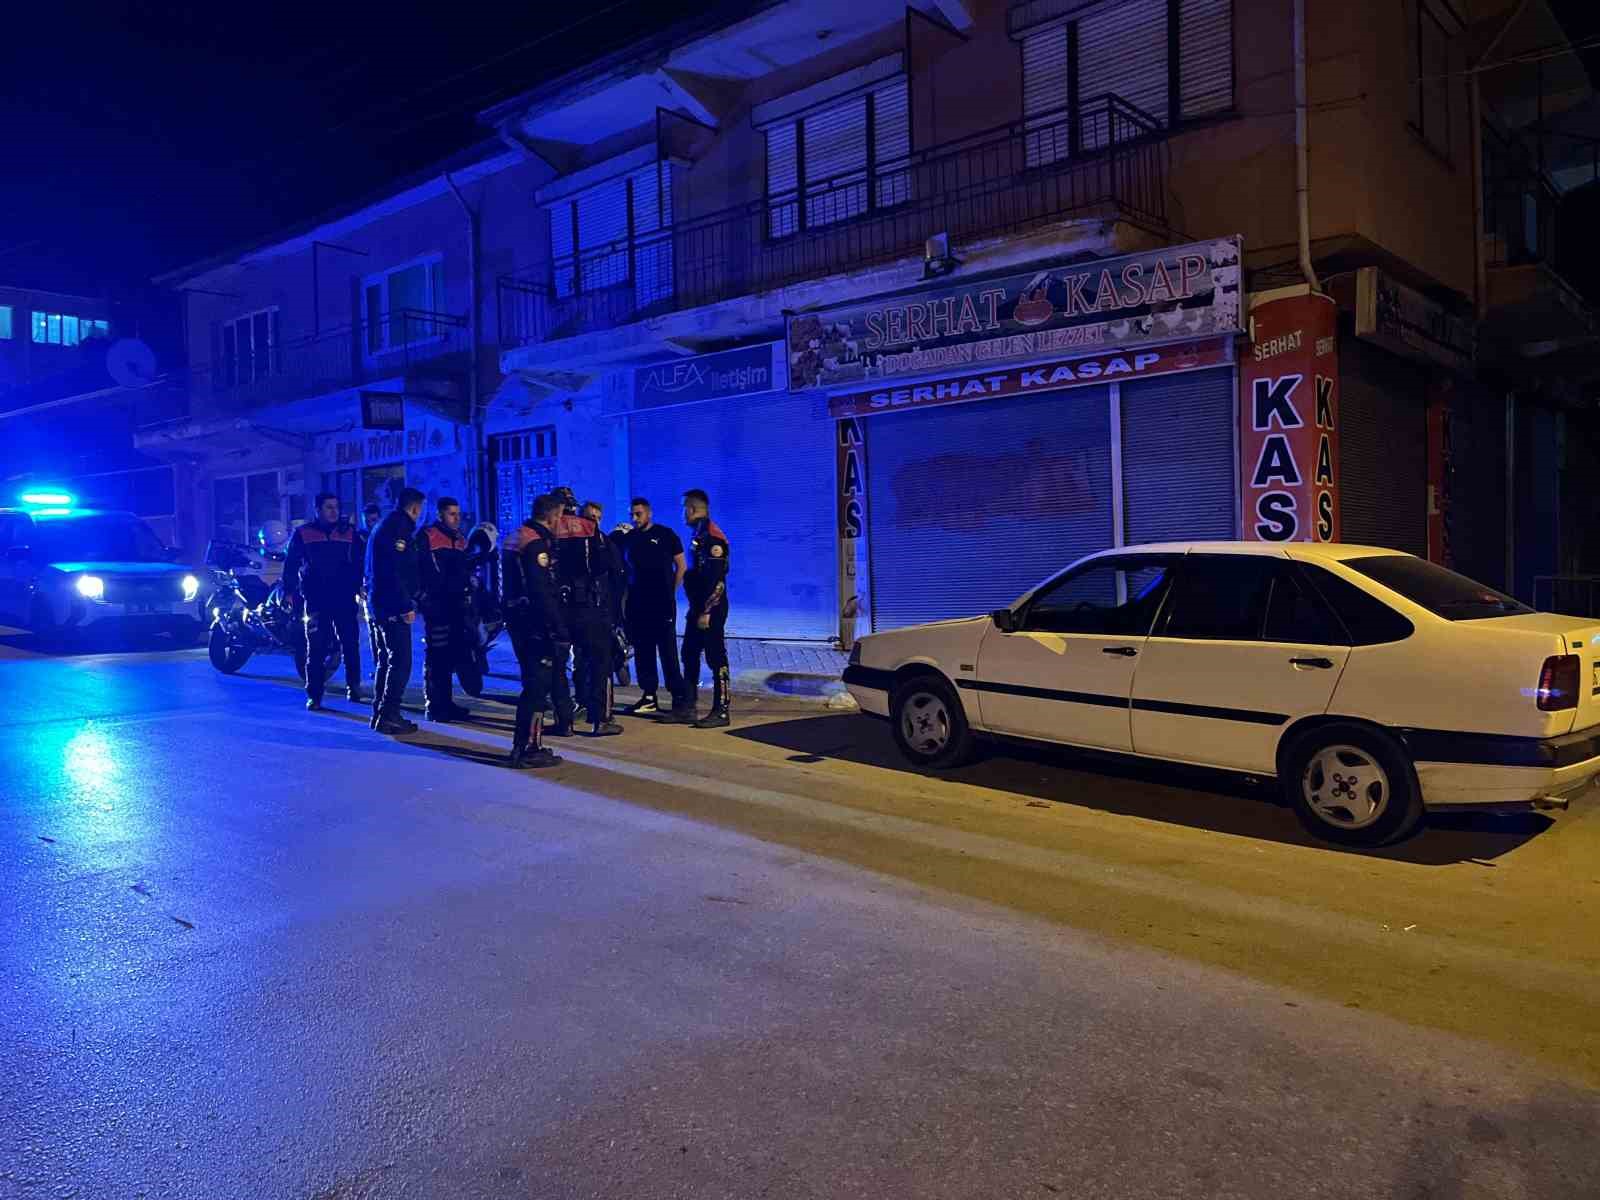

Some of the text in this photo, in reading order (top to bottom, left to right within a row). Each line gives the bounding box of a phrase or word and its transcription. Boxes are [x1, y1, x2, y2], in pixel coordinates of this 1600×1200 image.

[864, 255, 1206, 350] SERHAT KASAP
[975, 336, 1034, 362] GELEN
[1254, 330, 1303, 361] SERHAT
[642, 363, 707, 392] ALFA
[870, 352, 1161, 408] SERHAT KASAP
